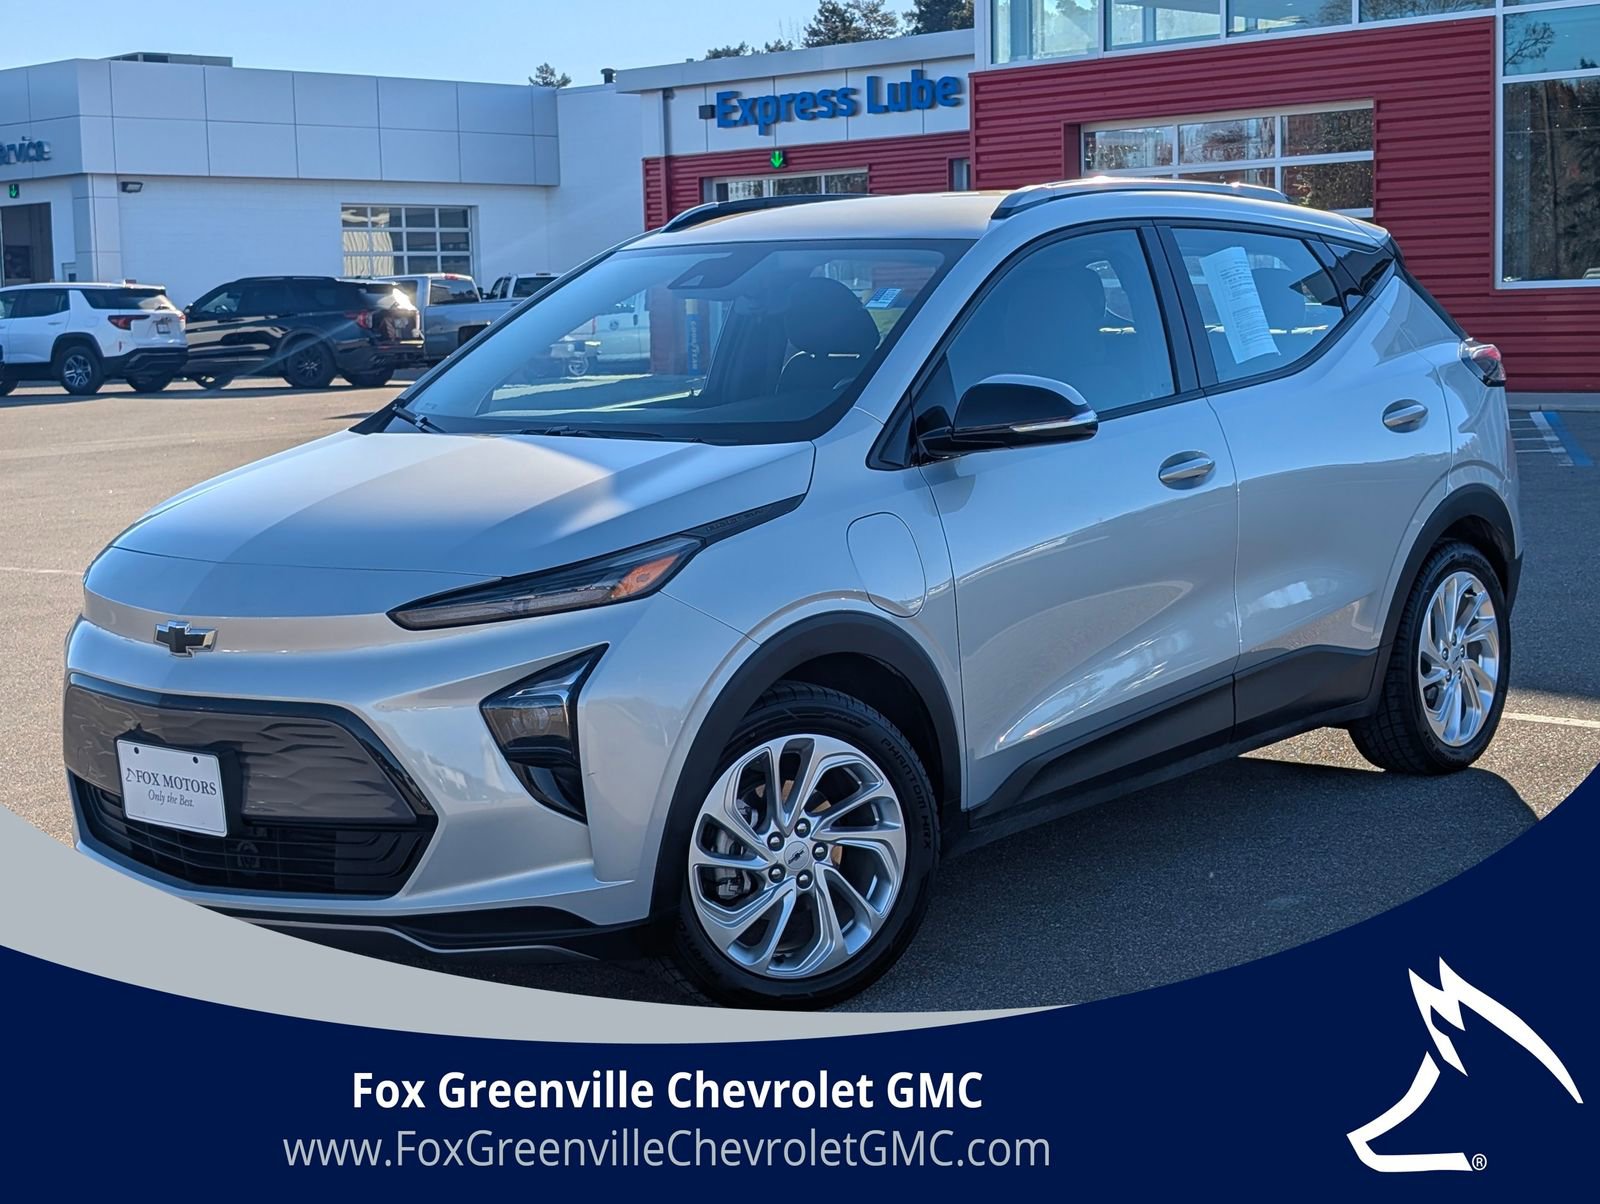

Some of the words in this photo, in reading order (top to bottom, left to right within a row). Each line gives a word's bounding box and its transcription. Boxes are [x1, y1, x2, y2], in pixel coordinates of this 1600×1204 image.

[716, 87, 858, 136] Express
[866, 69, 962, 114] Lube
[136, 770, 160, 786] FOX
[163, 775, 217, 795] MOTORS
[880, 738, 928, 810] PHANTOM
[149, 789, 166, 805] Only
[167, 794, 177, 805] the
[179, 794, 195, 808] Best.
